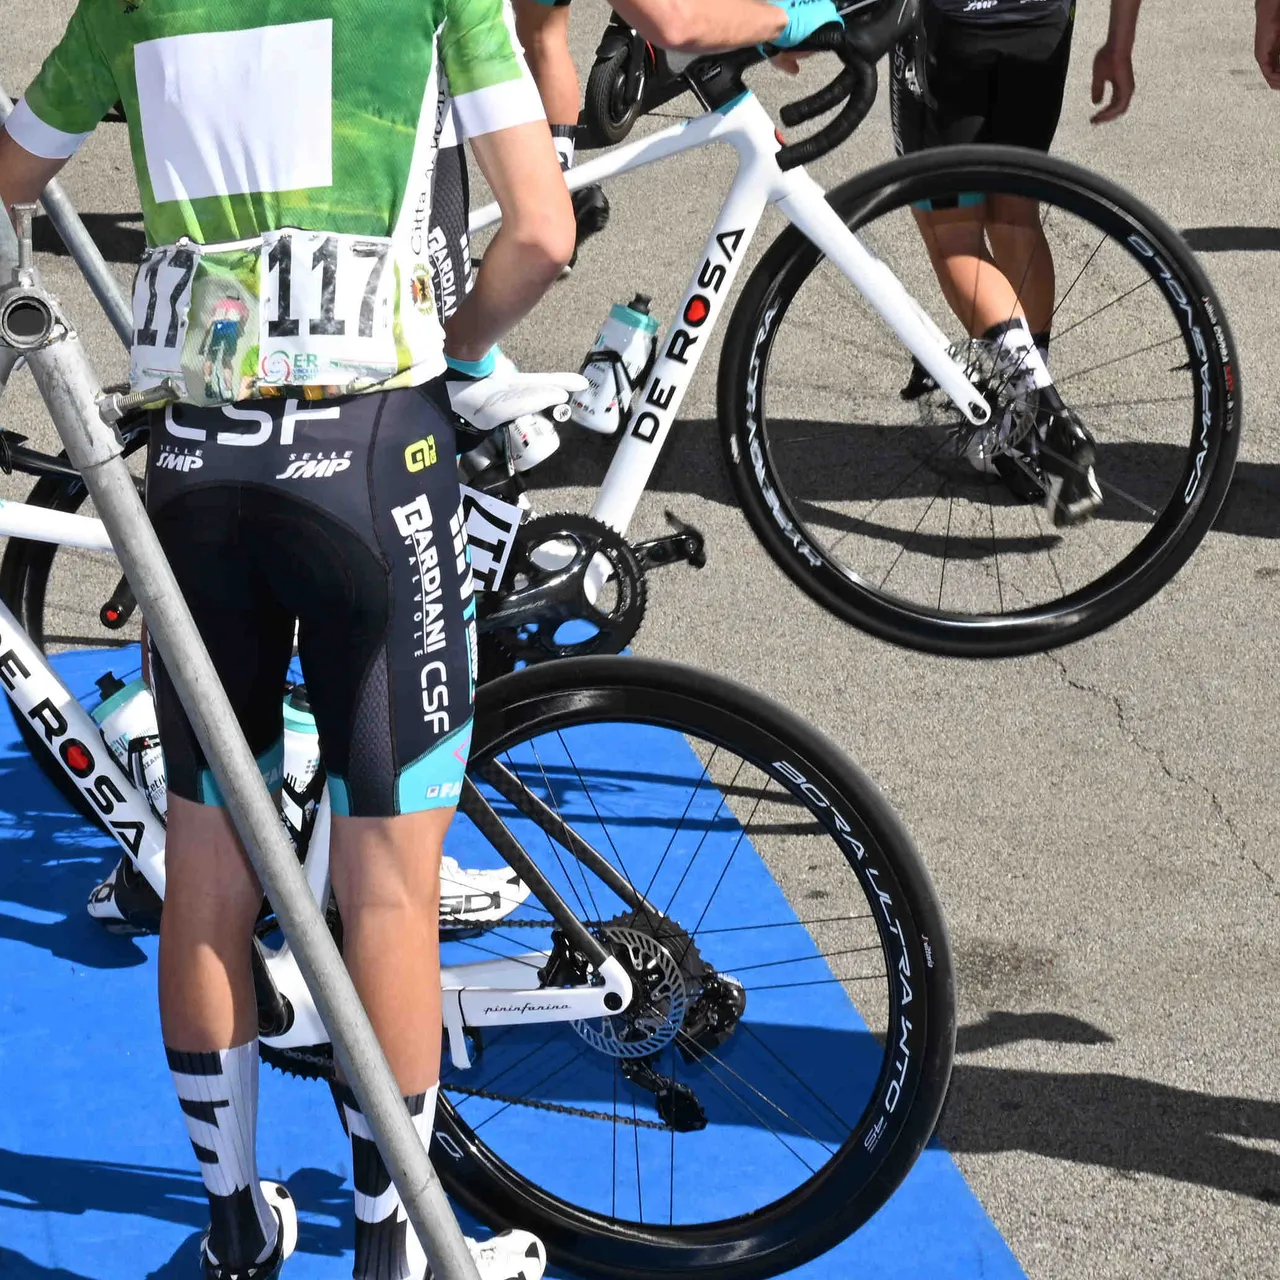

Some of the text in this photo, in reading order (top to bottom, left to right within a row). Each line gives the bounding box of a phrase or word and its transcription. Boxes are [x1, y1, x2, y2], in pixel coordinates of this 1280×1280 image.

[268, 236, 390, 338] 117
[630, 228, 746, 444] DE ROSA
[156, 452, 204, 472] SMP
[164, 398, 340, 447] CSF
[276, 458, 352, 480] SMP
[289, 451, 353, 461] SELLE
[391, 494, 450, 734] BARDIANI CSF
[28, 697, 147, 856] ROSA
[772, 759, 914, 1115] BORA ULTRA WTO
